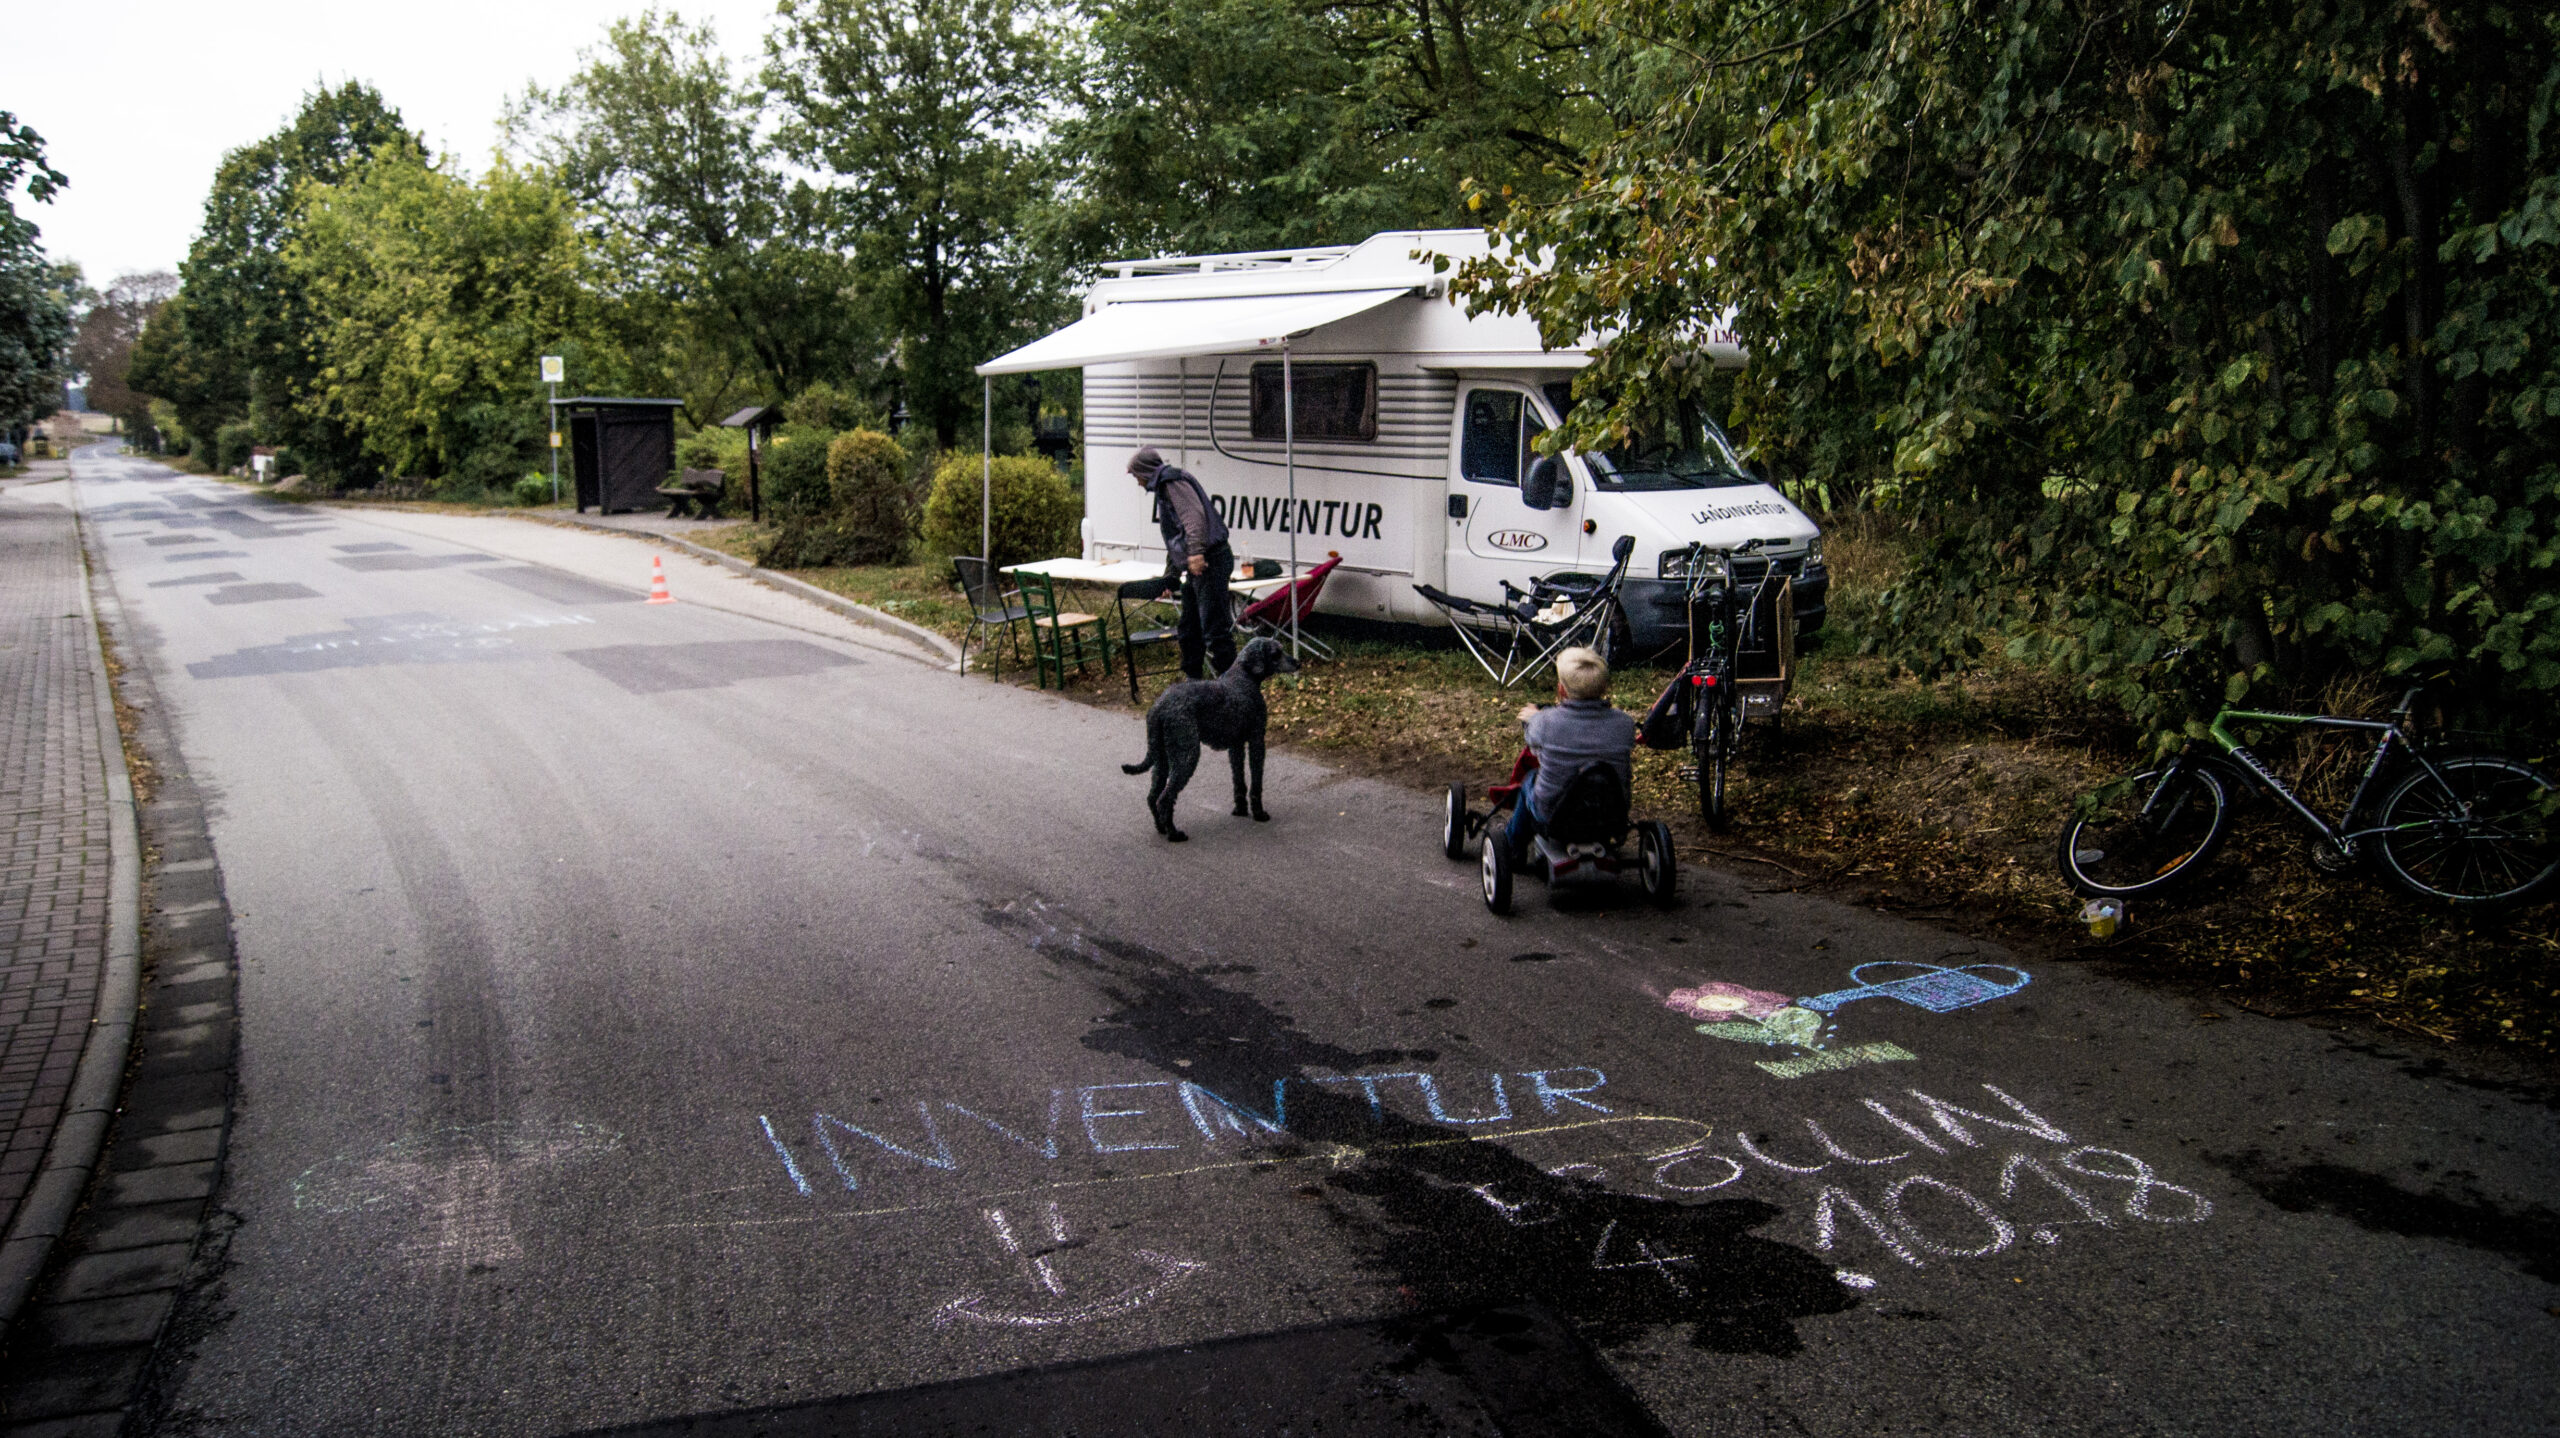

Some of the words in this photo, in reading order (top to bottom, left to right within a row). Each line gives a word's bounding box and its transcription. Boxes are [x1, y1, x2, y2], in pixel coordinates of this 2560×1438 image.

[1152, 494, 1384, 540] LDINVENTUR
[1691, 503, 1790, 525] LANDINVENTUR
[1499, 532, 1536, 548] LMC
[759, 1067, 1613, 1196] INVENTUR
